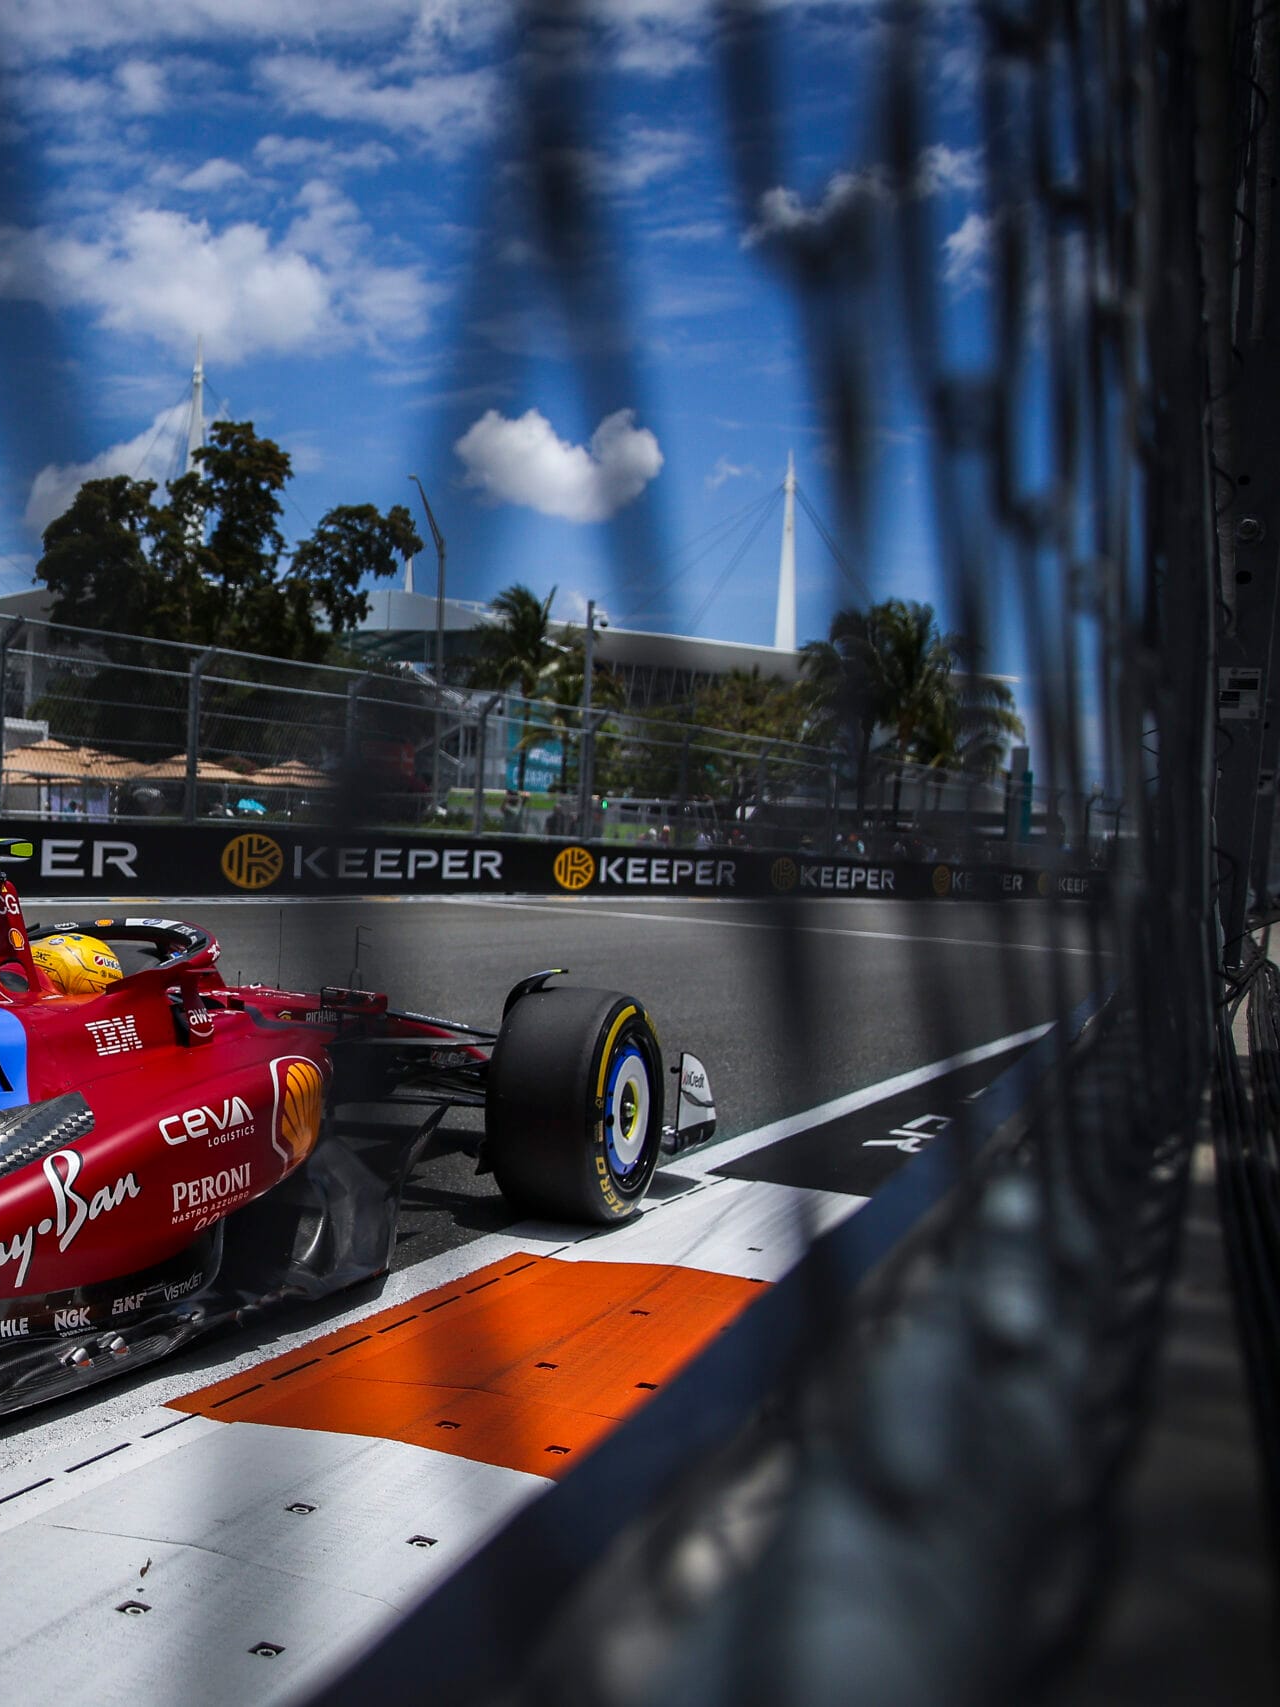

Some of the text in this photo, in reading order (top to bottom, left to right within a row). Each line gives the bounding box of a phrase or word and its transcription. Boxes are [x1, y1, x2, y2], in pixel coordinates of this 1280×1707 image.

[293, 845, 504, 880] KEEPER
[598, 855, 737, 887] KEEPER
[799, 864, 896, 892] KEEPER
[187, 1007, 213, 1026] aws
[85, 1014, 143, 1056] IBM
[207, 1125, 255, 1148] LOGISTICS
[171, 1162, 251, 1213] PERONI
[171, 1190, 250, 1225] NASTRO AZZURRO
[54, 1306, 91, 1331] NGK
[111, 1292, 148, 1315] SKF
